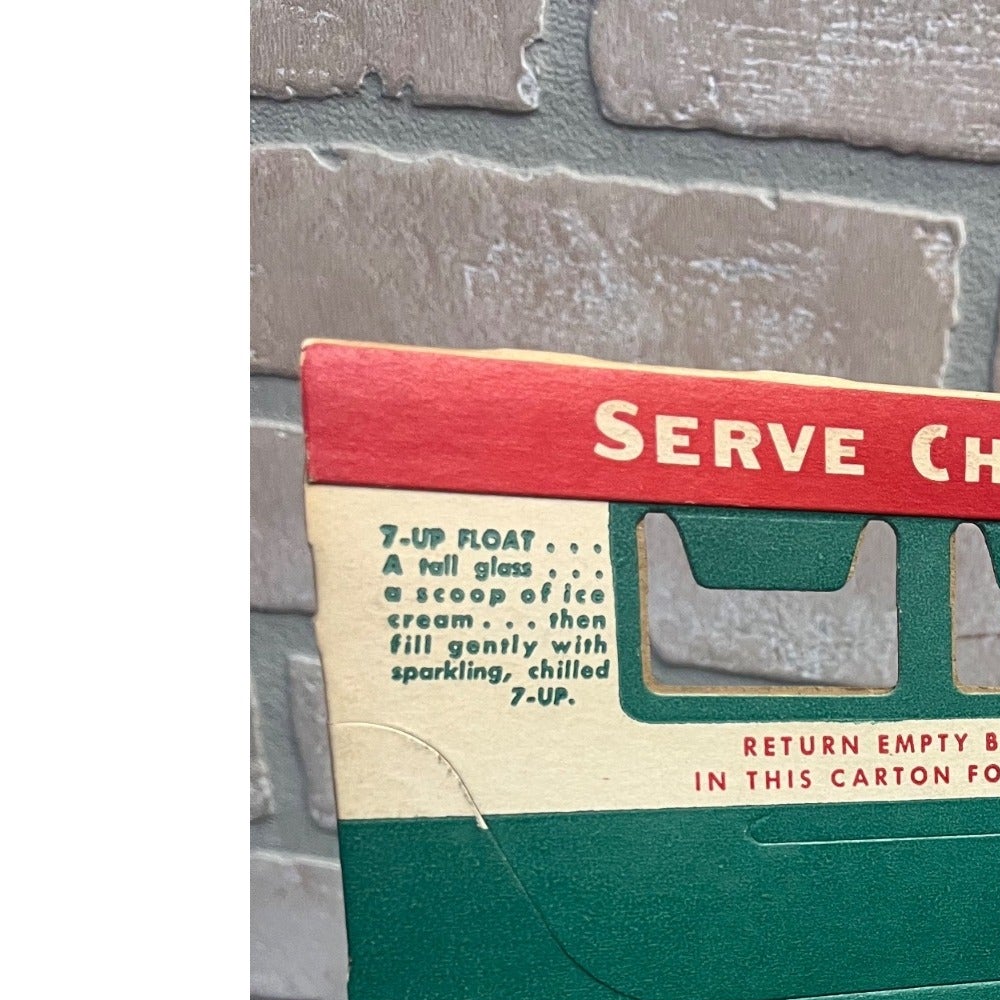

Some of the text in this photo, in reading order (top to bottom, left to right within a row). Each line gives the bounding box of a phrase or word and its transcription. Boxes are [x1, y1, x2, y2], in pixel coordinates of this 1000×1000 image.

[594, 400, 865, 476] SERVE
[379, 524, 445, 550] 7-UP
[458, 528, 535, 552] FLOAT
[382, 554, 403, 576] A
[419, 554, 458, 576] tall
[474, 556, 532, 581] glass
[384, 582, 605, 607] a scoop of ice
[388, 614, 473, 629] cream
[550, 608, 606, 629] then
[390, 634, 607, 658] fill gently with
[391, 659, 610, 684] sparkling, chilled
[510, 687, 575, 706] 7-UP.
[743, 734, 859, 757] RETURN
[878, 733, 968, 755] EMPTY
[694, 770, 726, 791] IN
[746, 769, 812, 790] THIS
[831, 765, 950, 789] CARTON
